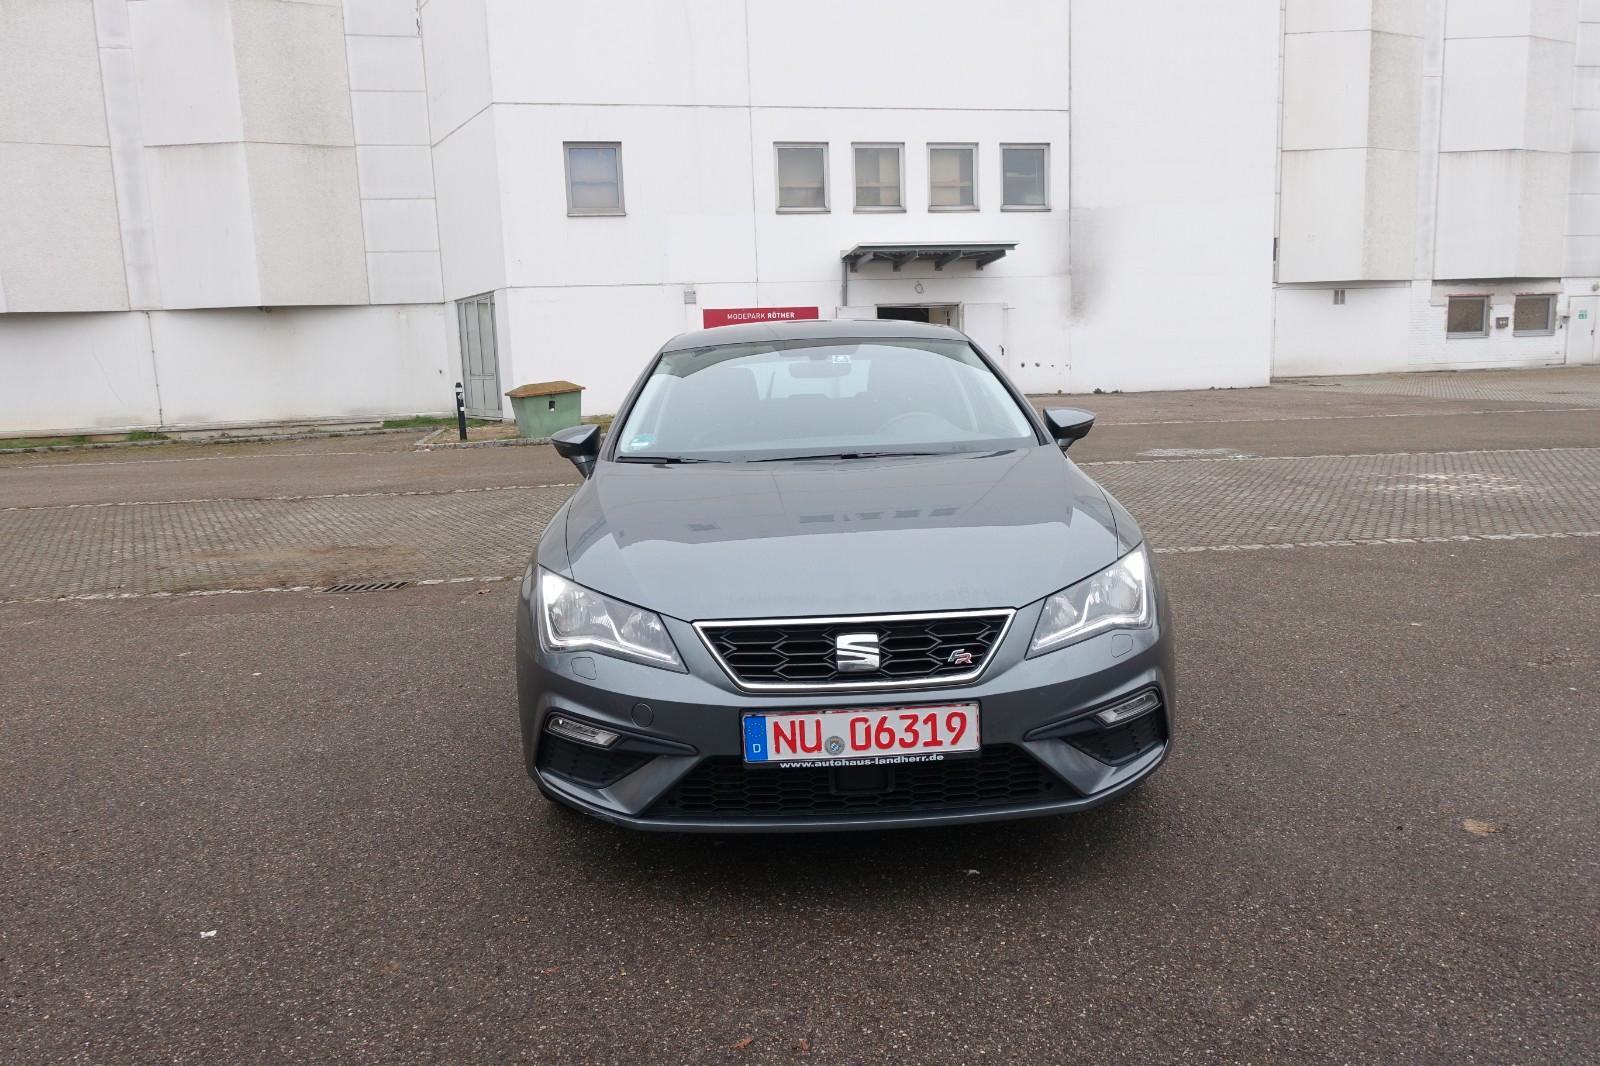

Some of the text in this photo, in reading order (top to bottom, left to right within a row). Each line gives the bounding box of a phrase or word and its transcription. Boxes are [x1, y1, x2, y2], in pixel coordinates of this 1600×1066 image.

[753, 711, 968, 754] D NU 06319
[780, 753, 944, 769] www.autohaus-landherr.de
